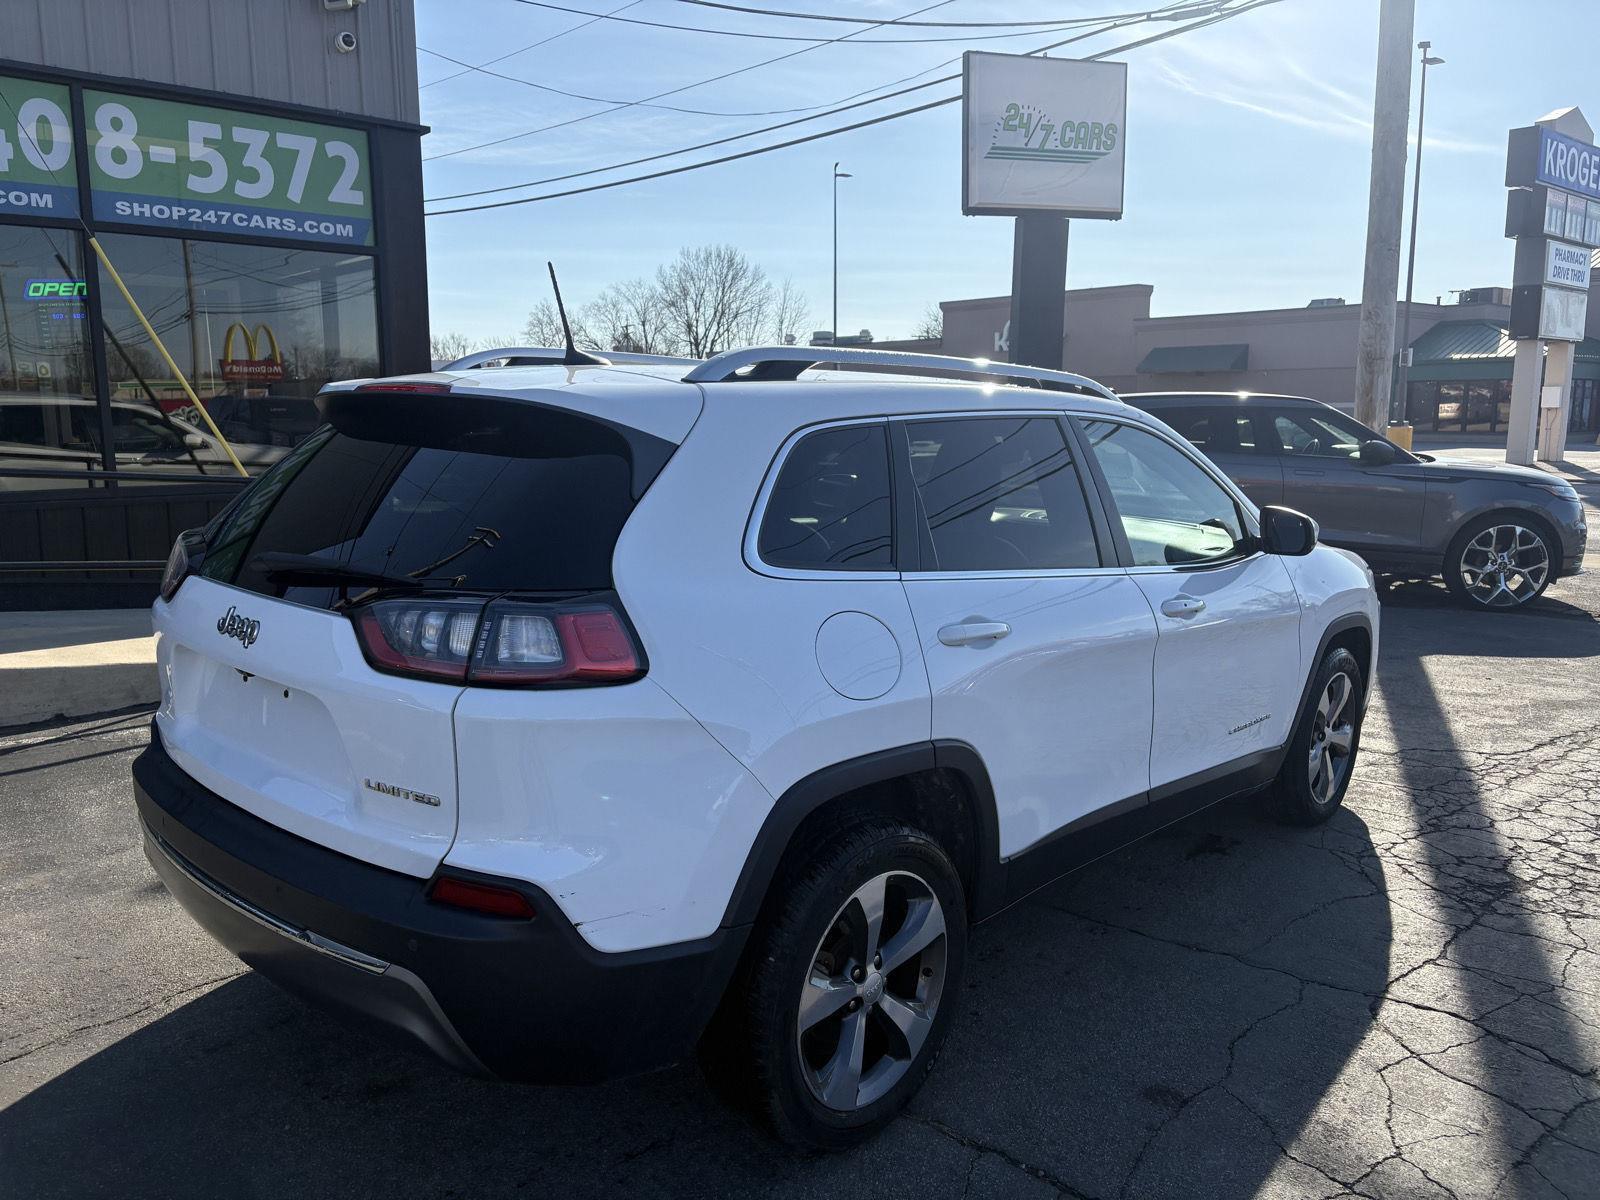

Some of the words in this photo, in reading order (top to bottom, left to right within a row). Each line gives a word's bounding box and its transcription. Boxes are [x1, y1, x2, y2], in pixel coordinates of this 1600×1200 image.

[1059, 120, 1118, 151] CARS
[1544, 138, 1600, 190] KROGE
[115, 200, 354, 239] SHOP247CARS.COM
[1554, 247, 1588, 267] PHARMACY
[1552, 264, 1570, 281] DRIVE
[1570, 268, 1586, 283] THRU
[28, 282, 88, 297] OPEN
[217, 606, 261, 649] Jeep
[364, 778, 441, 807] LIMITED
